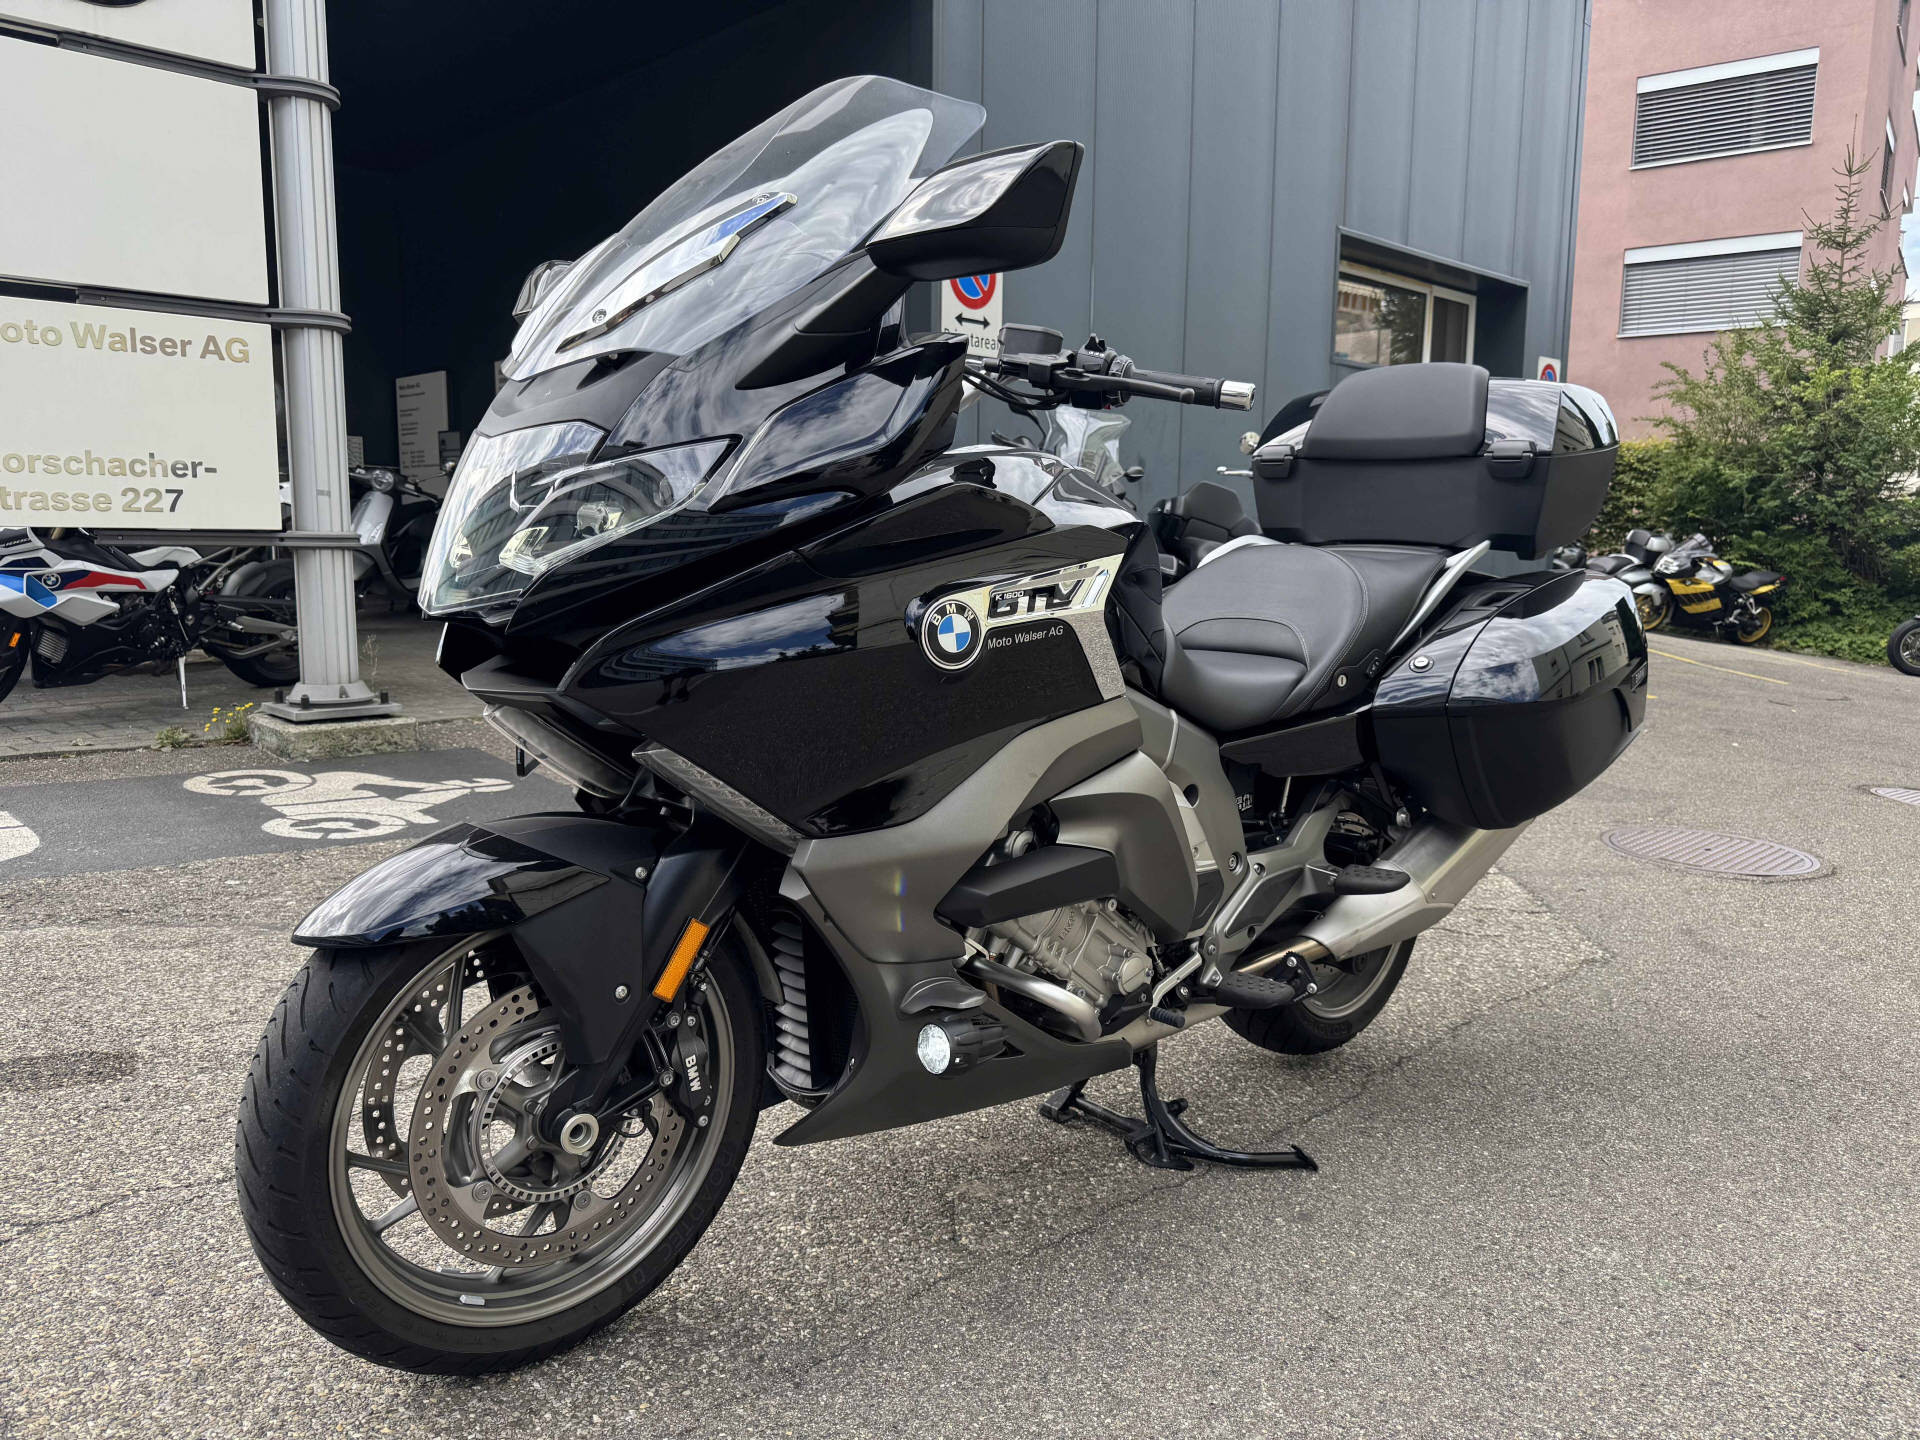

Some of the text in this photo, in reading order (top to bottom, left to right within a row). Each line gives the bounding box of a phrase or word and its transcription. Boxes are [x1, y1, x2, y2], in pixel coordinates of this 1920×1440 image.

[0, 320, 250, 363] oto Walser AG
[0, 450, 217, 478] orschacher-
[0, 486, 184, 513] trasse 227
[1004, 590, 1024, 599] 1600
[931, 603, 975, 627] BMW
[987, 625, 1064, 650] Moto Walser AG
[685, 1054, 702, 1091] BMW
